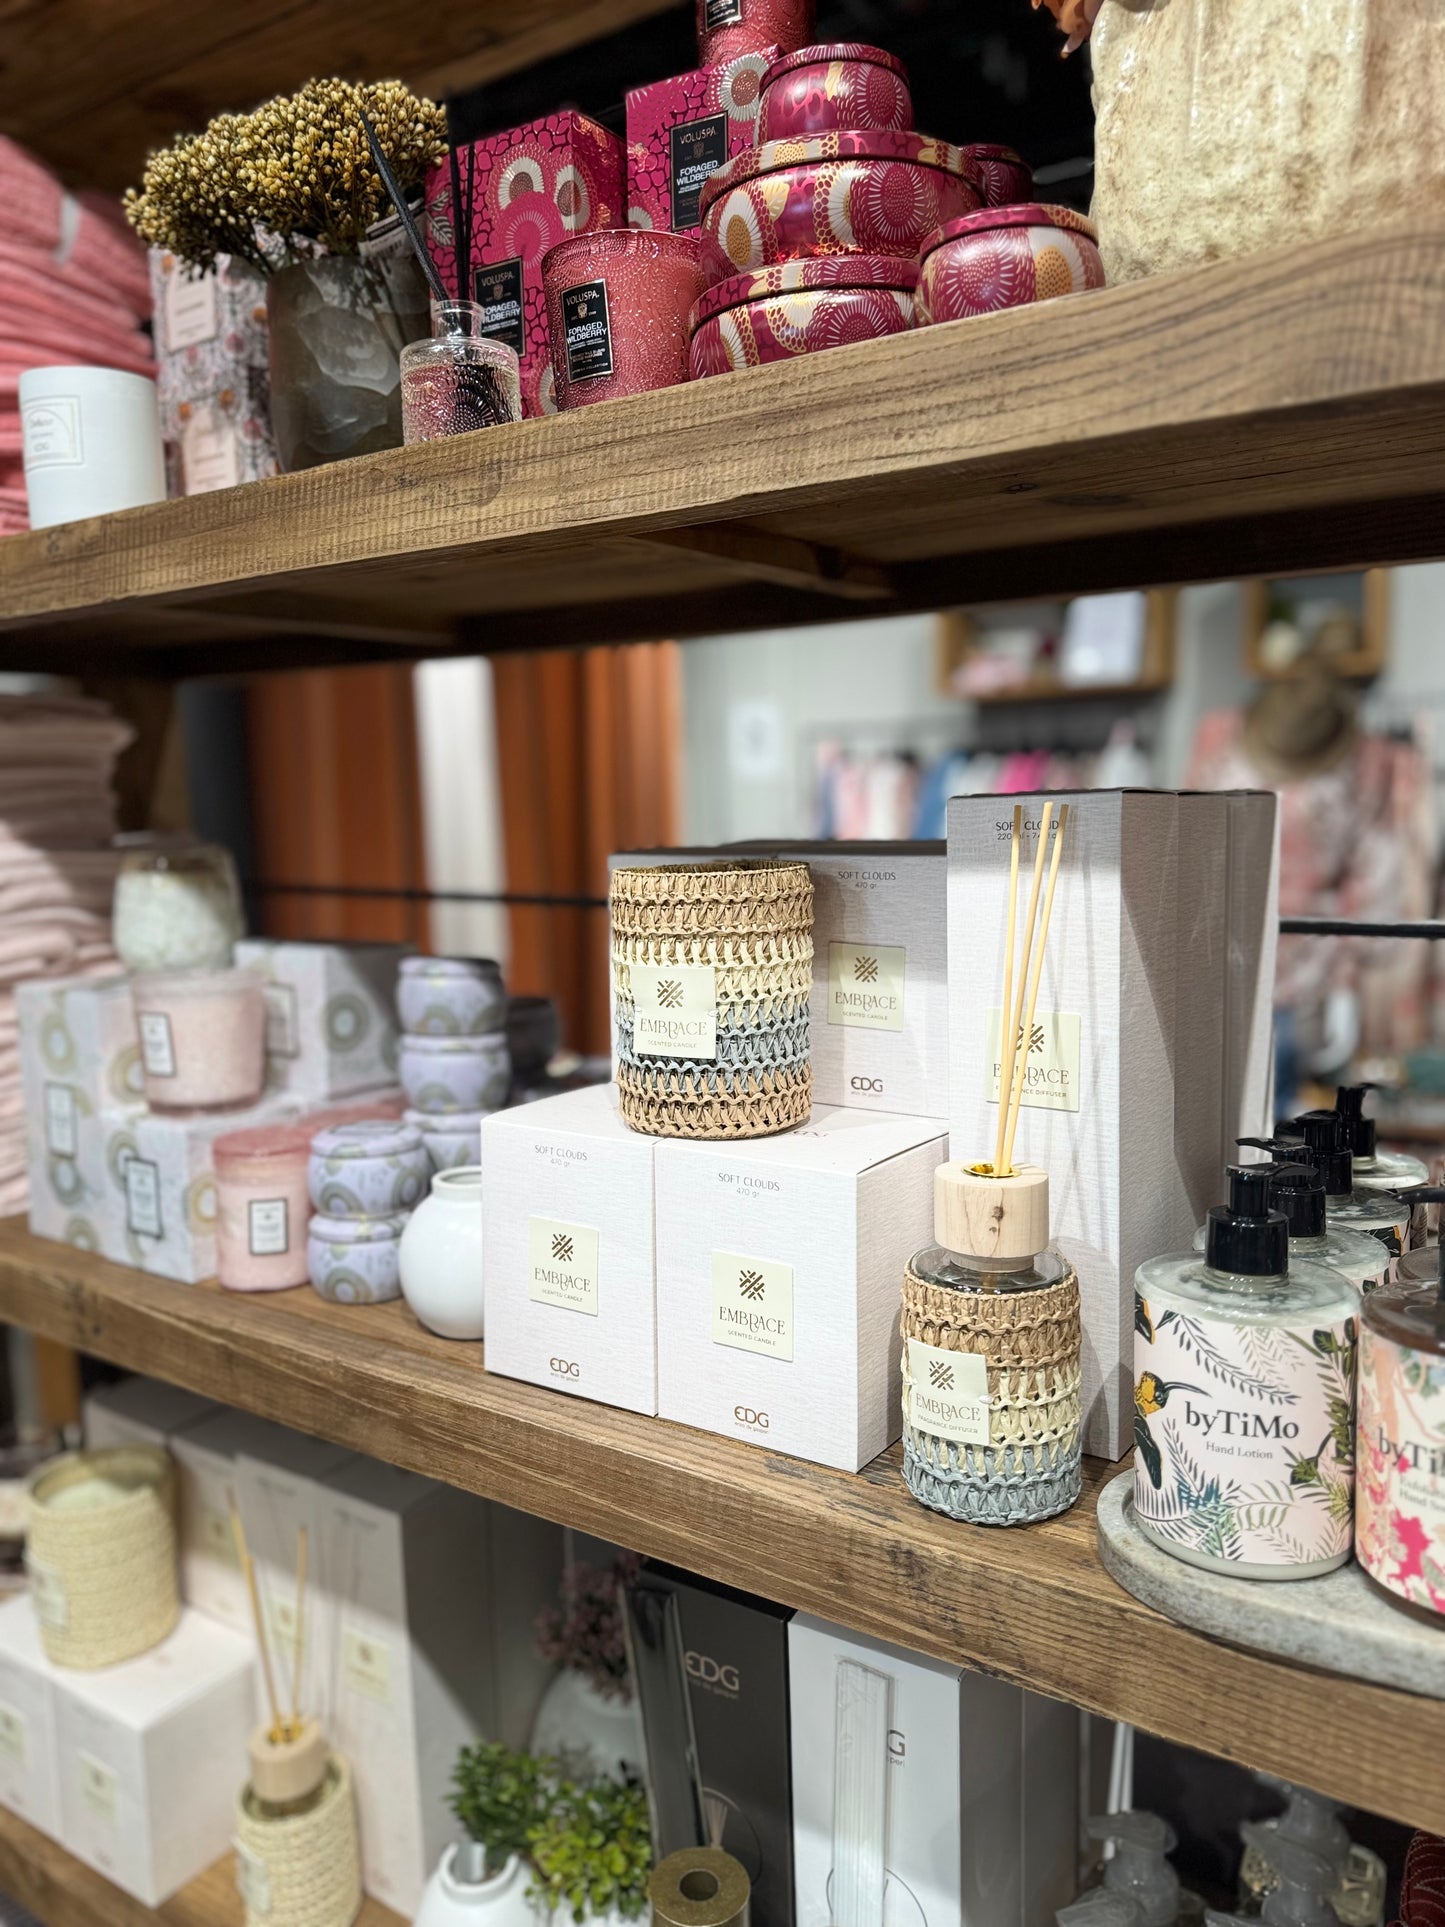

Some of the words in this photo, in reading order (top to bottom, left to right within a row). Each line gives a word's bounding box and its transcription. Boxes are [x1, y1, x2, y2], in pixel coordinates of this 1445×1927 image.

[676, 169, 720, 187] WILDBERR
[483, 307, 521, 323] ILDBERRY
[566, 328, 607, 344] WILDBERRY
[568, 321, 603, 336] FORAGED
[995, 821, 1015, 831] SOF
[838, 871, 859, 880] SOFT
[861, 871, 896, 880] CLOUDS
[835, 991, 897, 1012] EMBRACE
[640, 1018, 707, 1039] EMBRACE
[850, 1076, 884, 1093] EDG
[993, 1063, 1069, 1087] ERACE
[534, 1144, 554, 1155] SOFT
[556, 1148, 588, 1161] CLOUDS
[718, 1172, 740, 1184] SOFT
[743, 1176, 780, 1192] CLOUDS
[535, 1267, 591, 1292] EMBRACE
[719, 1306, 786, 1335] EMBRACE
[727, 1329, 753, 1340] SCENTED
[753, 1336, 776, 1347] CANDLE
[550, 1357, 580, 1377] EDG
[734, 1405, 769, 1428] EDG
[916, 1393, 981, 1421] EMBRACE
[1185, 1400, 1299, 1439] byTiMo
[1206, 1440, 1234, 1455] Hand
[1237, 1447, 1273, 1459] Lotion
[1378, 1425, 1445, 1477] byTi
